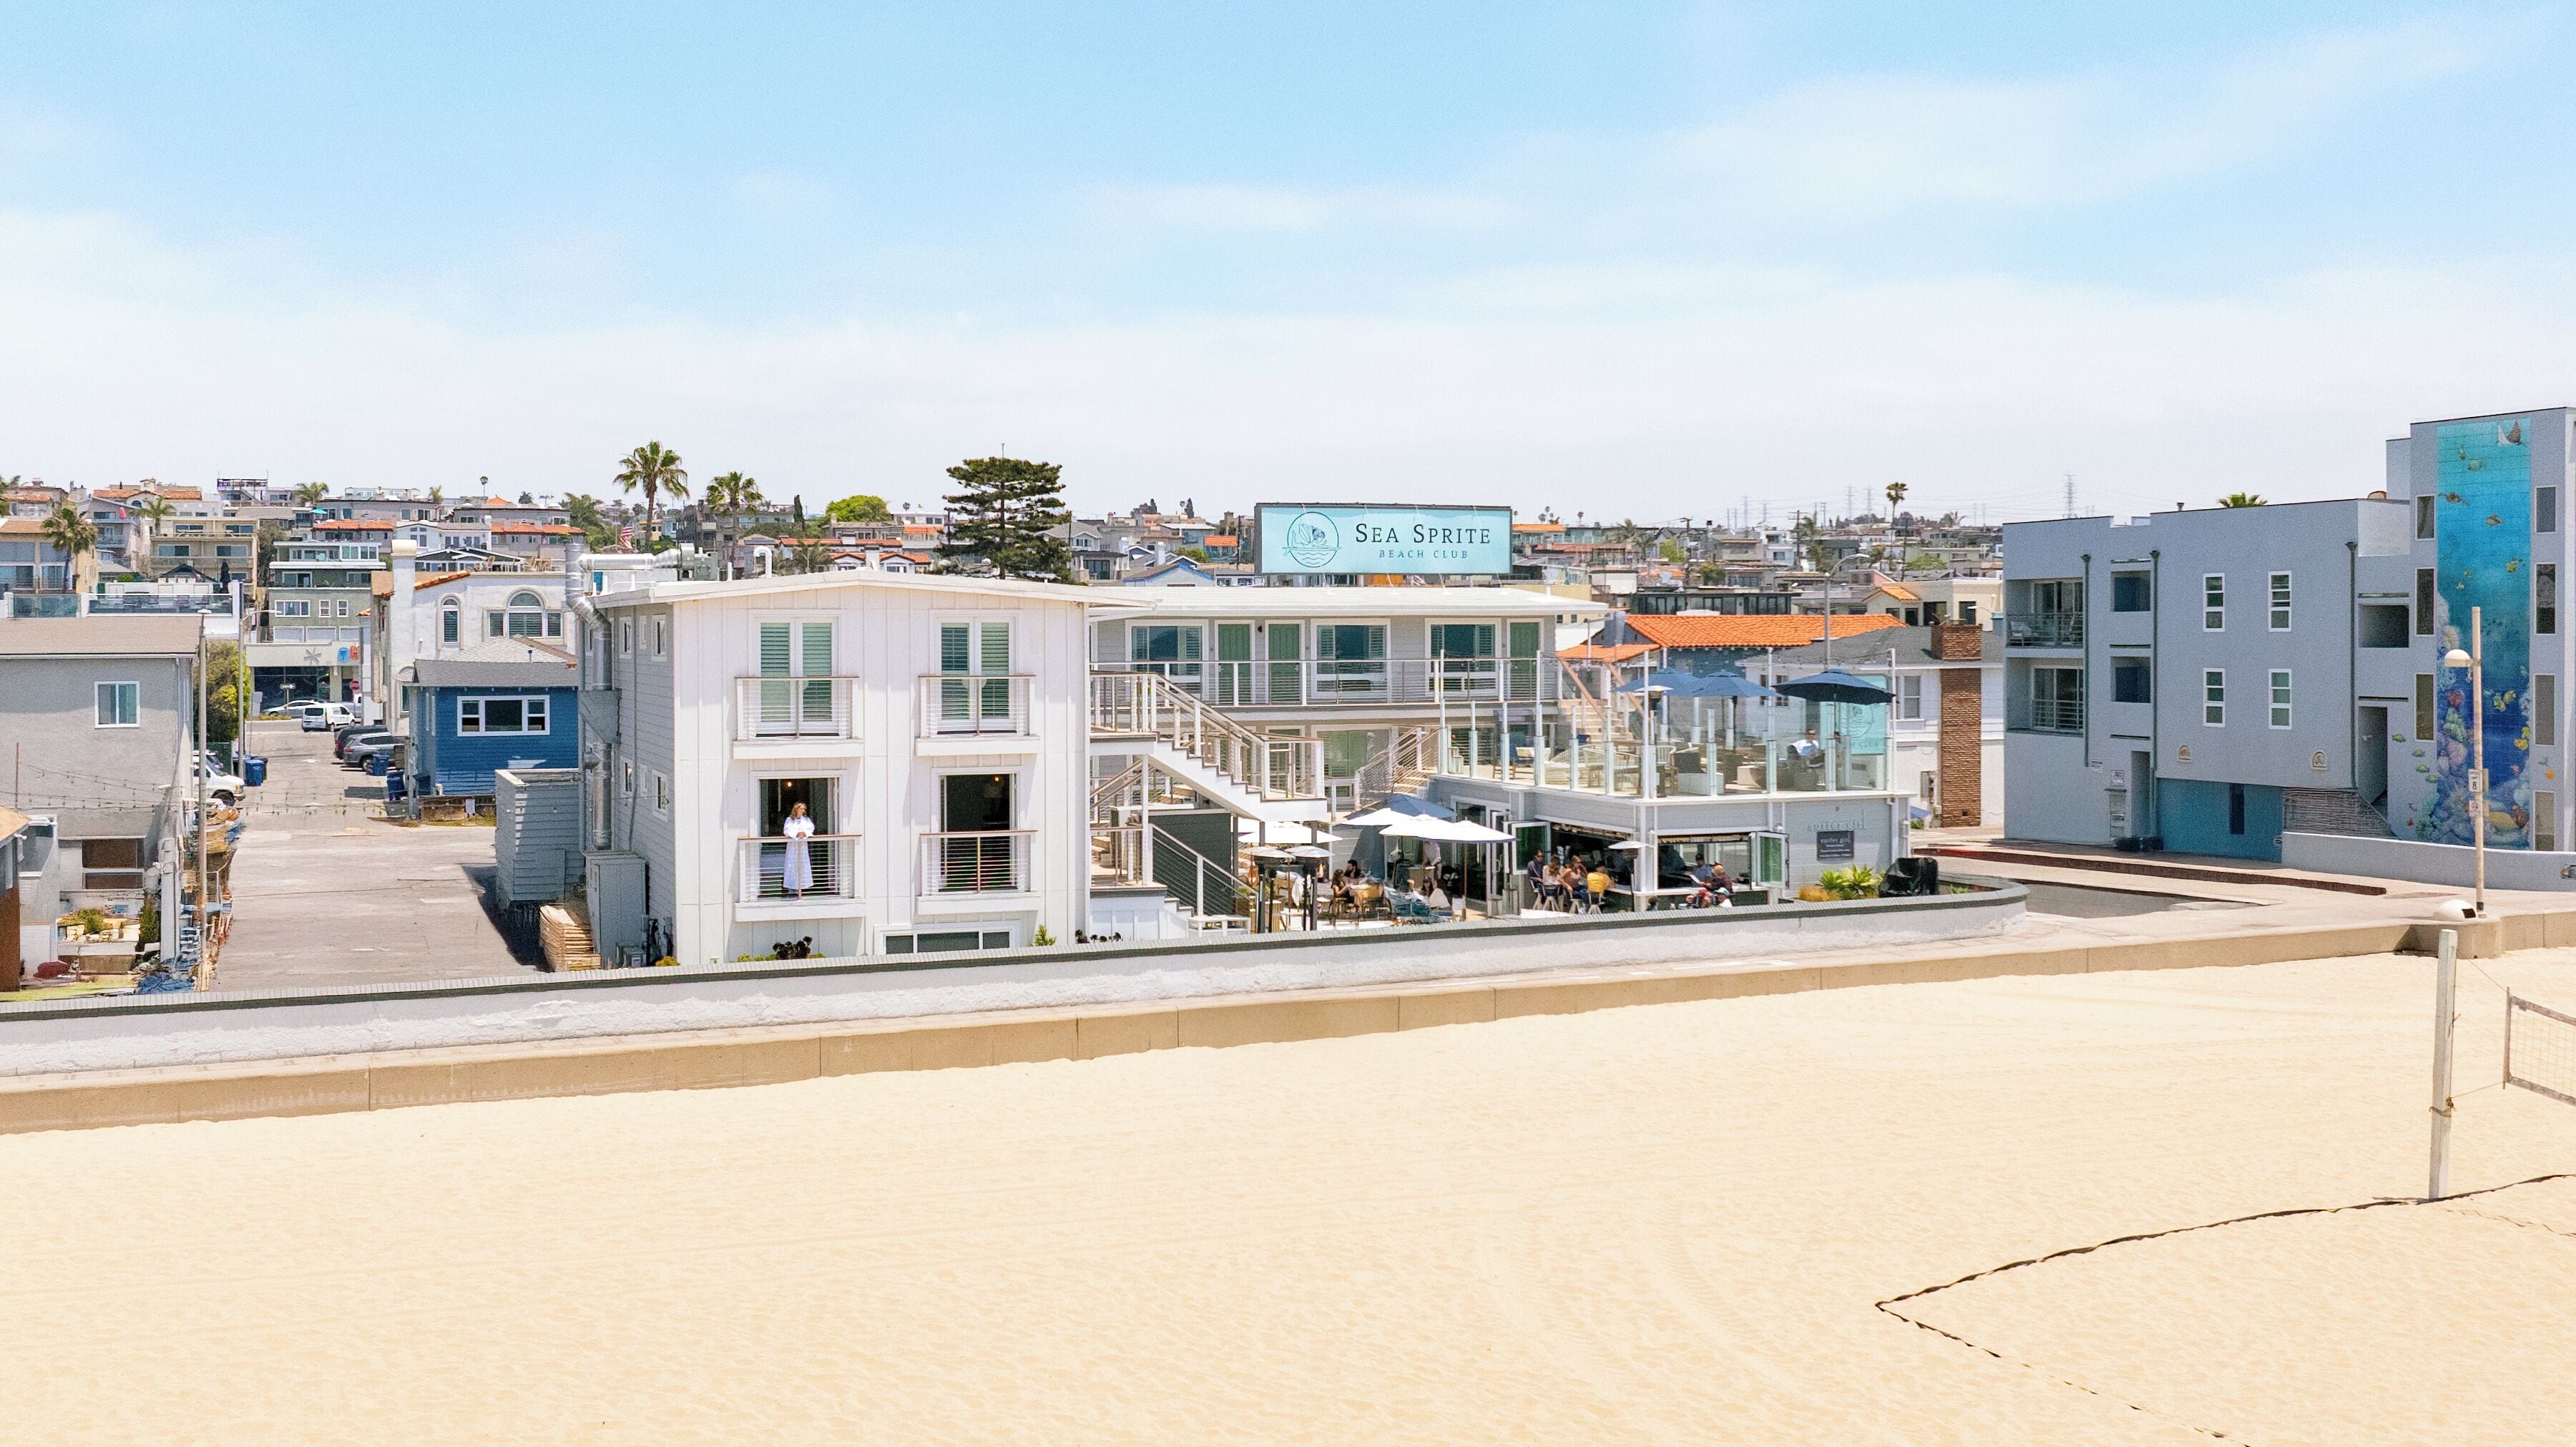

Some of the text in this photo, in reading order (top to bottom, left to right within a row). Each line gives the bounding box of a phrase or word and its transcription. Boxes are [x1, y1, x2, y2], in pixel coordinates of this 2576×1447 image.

[1356, 524, 1490, 544] SEA SPRITE
[1379, 549, 1467, 559] BEACH CLUB
[1807, 820, 1843, 830] surfer
